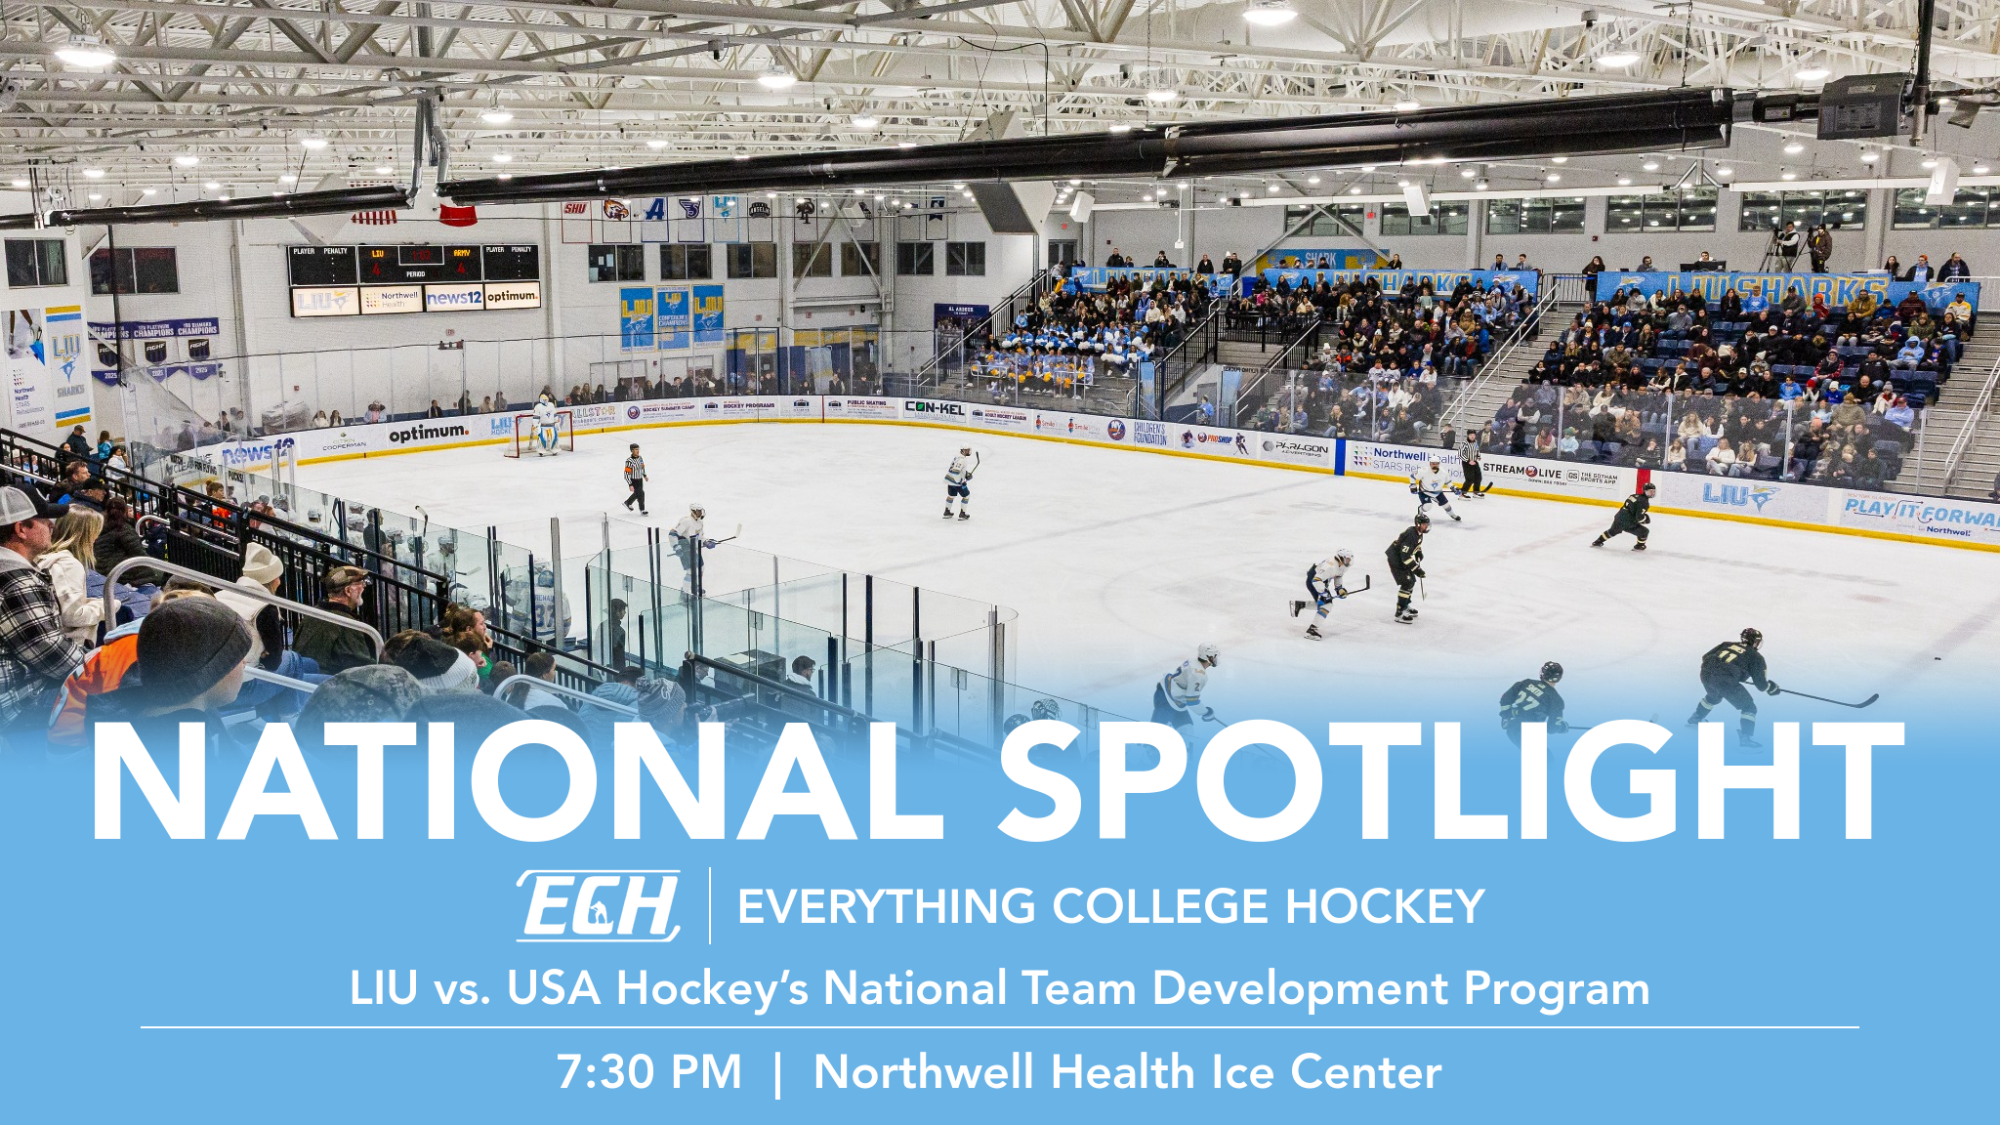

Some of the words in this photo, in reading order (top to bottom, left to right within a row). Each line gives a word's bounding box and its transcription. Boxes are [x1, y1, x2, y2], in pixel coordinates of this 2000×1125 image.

[564, 203, 587, 214] SHU
[323, 247, 347, 255] PENALTY
[371, 250, 384, 258] LIU
[372, 262, 380, 276] 4
[381, 291, 418, 300] Northwell
[426, 290, 482, 305] news12
[1667, 274, 1729, 306] LIU
[1735, 275, 1891, 307] SHARKS
[297, 292, 332, 310] LIU
[693, 296, 723, 315] LIU
[622, 299, 653, 318] LIU
[133, 328, 174, 338] CHAMPIONS
[177, 326, 217, 336] CHAMPIONS
[51, 334, 80, 360] LIU
[57, 384, 85, 398] SHARKS
[491, 416, 512, 431] LIU
[1133, 432, 1167, 446] FOUNDATION
[322, 442, 367, 451] COOPERMAN
[1275, 441, 1329, 454] PARAGON
[1373, 447, 1426, 462] Northwell
[1373, 460, 1403, 470] STARS
[1483, 462, 1524, 475] STREAM
[1538, 469, 1562, 479] LIVE
[1703, 482, 1749, 507] LIU
[1845, 498, 1896, 516] PLAY
[1900, 504, 1919, 518] IT
[1718, 650, 1737, 664] 11
[1194, 682, 1200, 692] 2
[1514, 690, 1540, 711] 27
